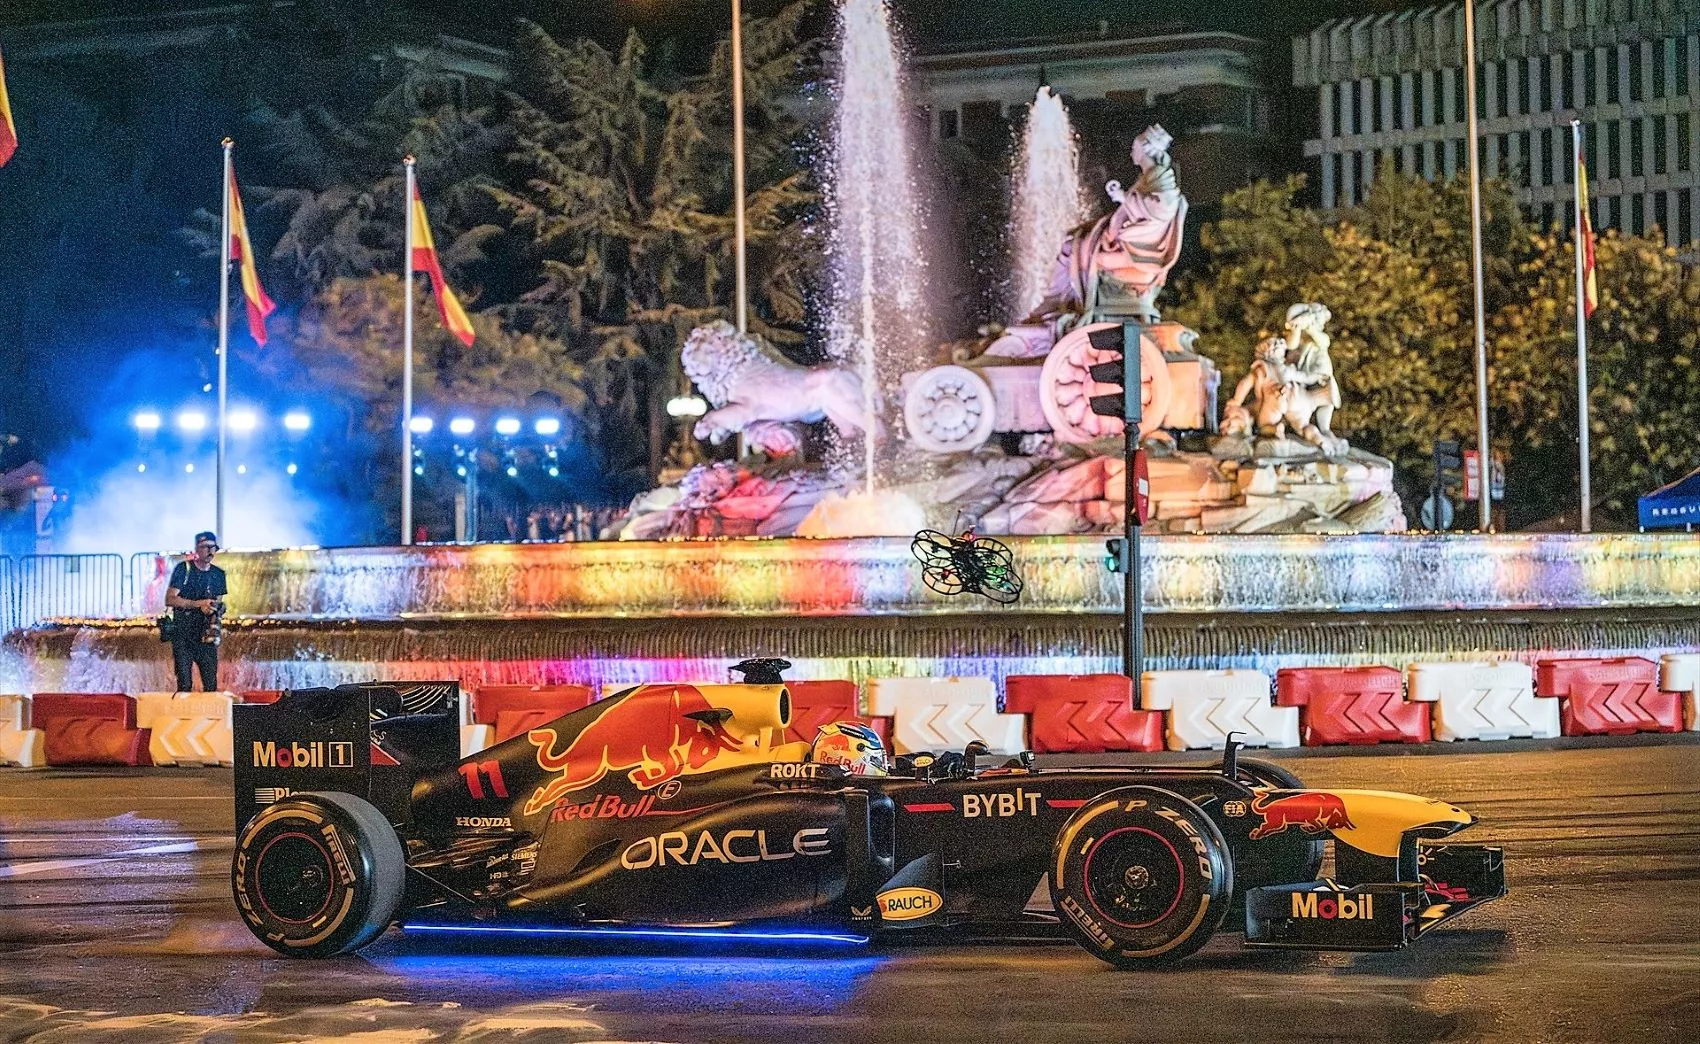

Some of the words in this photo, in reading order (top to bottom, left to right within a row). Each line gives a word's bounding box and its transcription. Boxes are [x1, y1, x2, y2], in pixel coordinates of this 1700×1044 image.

[253, 741, 323, 768] Mobil
[819, 750, 843, 764] Red
[843, 758, 866, 775] Bull
[458, 760, 509, 800] 11
[770, 763, 820, 778] ROKT
[551, 793, 602, 823] Red
[597, 794, 656, 818] Bull
[963, 788, 1042, 818] BYBIT
[455, 816, 512, 827] HONDA
[621, 827, 832, 869] ORACLE
[1124, 799, 1148, 812] P
[1154, 805, 1213, 880] ZERO
[888, 895, 932, 912] RAUCH
[1291, 892, 1373, 920] Mobil
